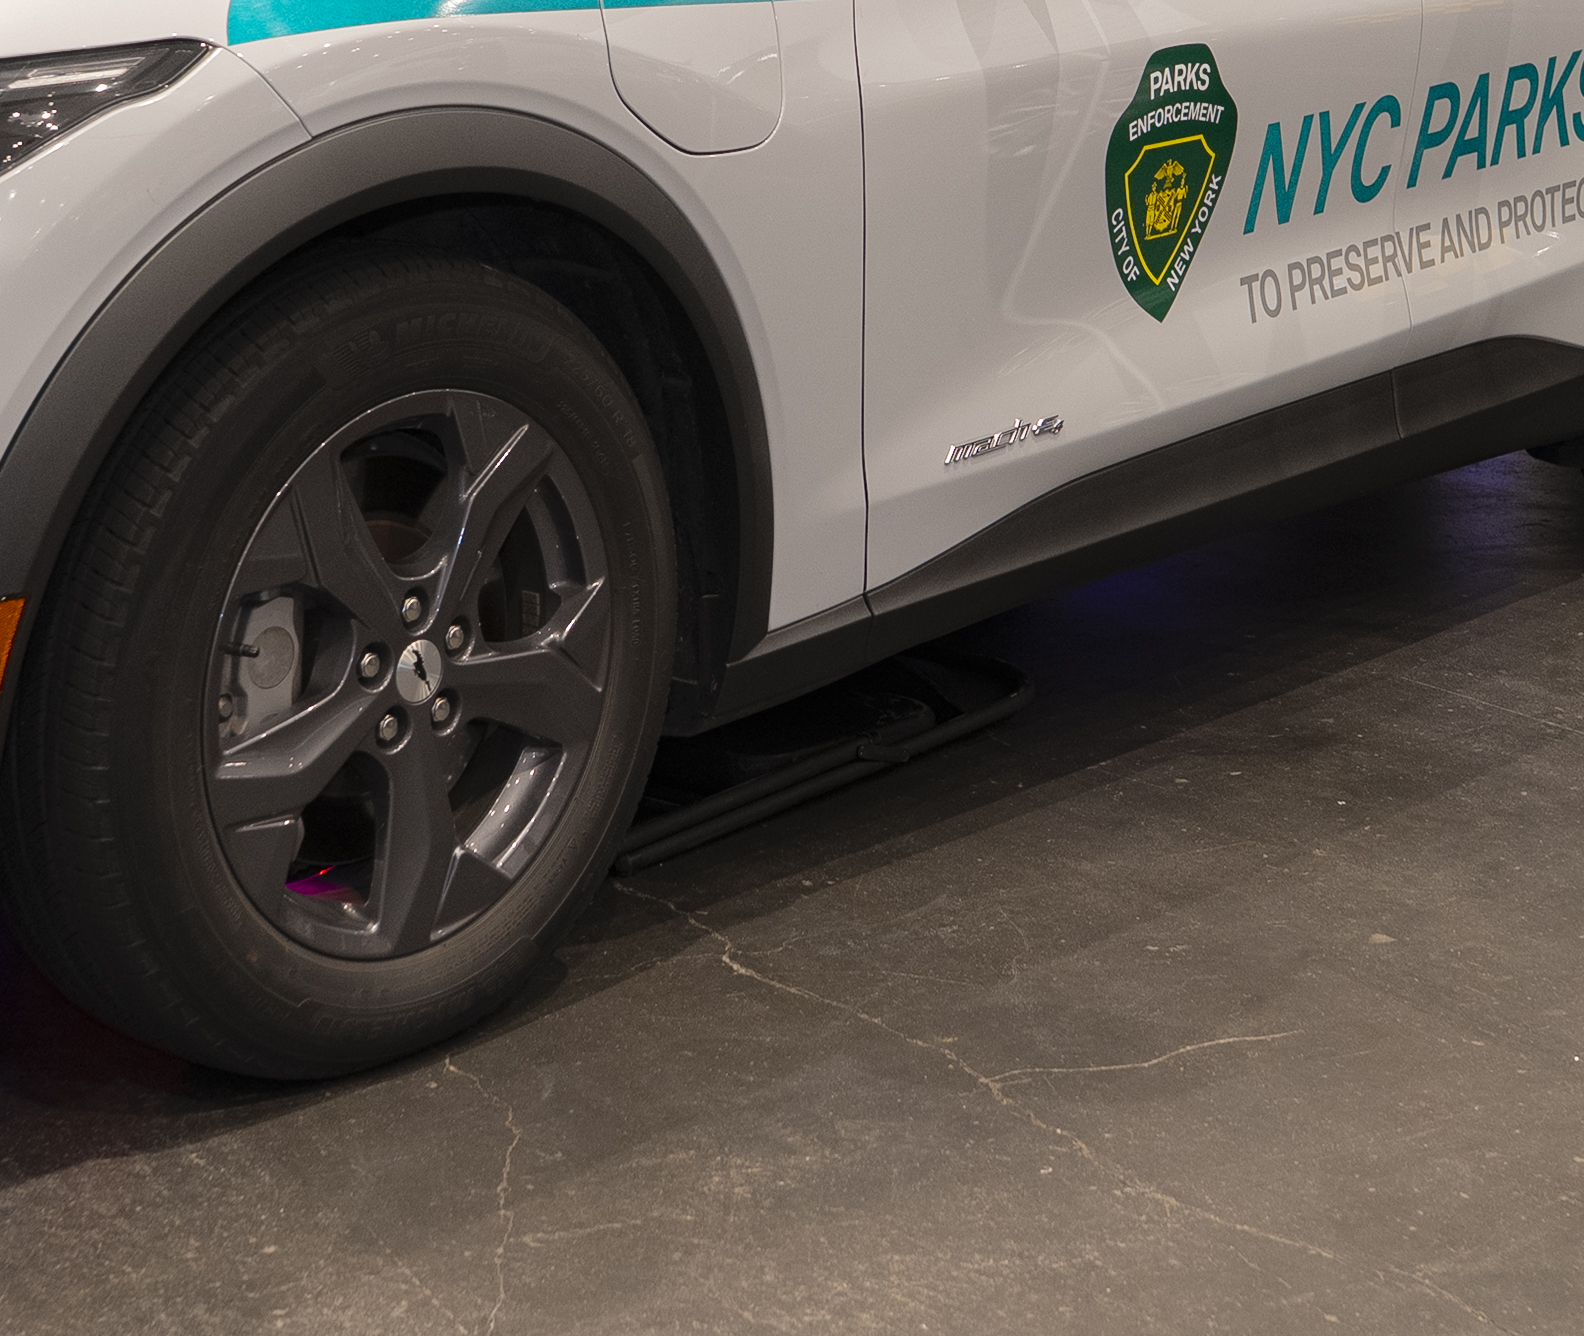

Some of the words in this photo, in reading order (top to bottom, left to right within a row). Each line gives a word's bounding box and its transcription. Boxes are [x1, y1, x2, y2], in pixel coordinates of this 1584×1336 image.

[1129, 101, 1225, 142] ENFORCEMENT
[1149, 62, 1212, 101] PARKS
[1242, 94, 1402, 235] NYC
[1111, 207, 1132, 254] CITY
[1123, 253, 1140, 283] OF
[1166, 241, 1197, 292] NEW
[1191, 172, 1223, 238] YORK
[1239, 268, 1282, 324] TO
[1288, 222, 1436, 311] PRESERVE
[1439, 205, 1493, 264] AND
